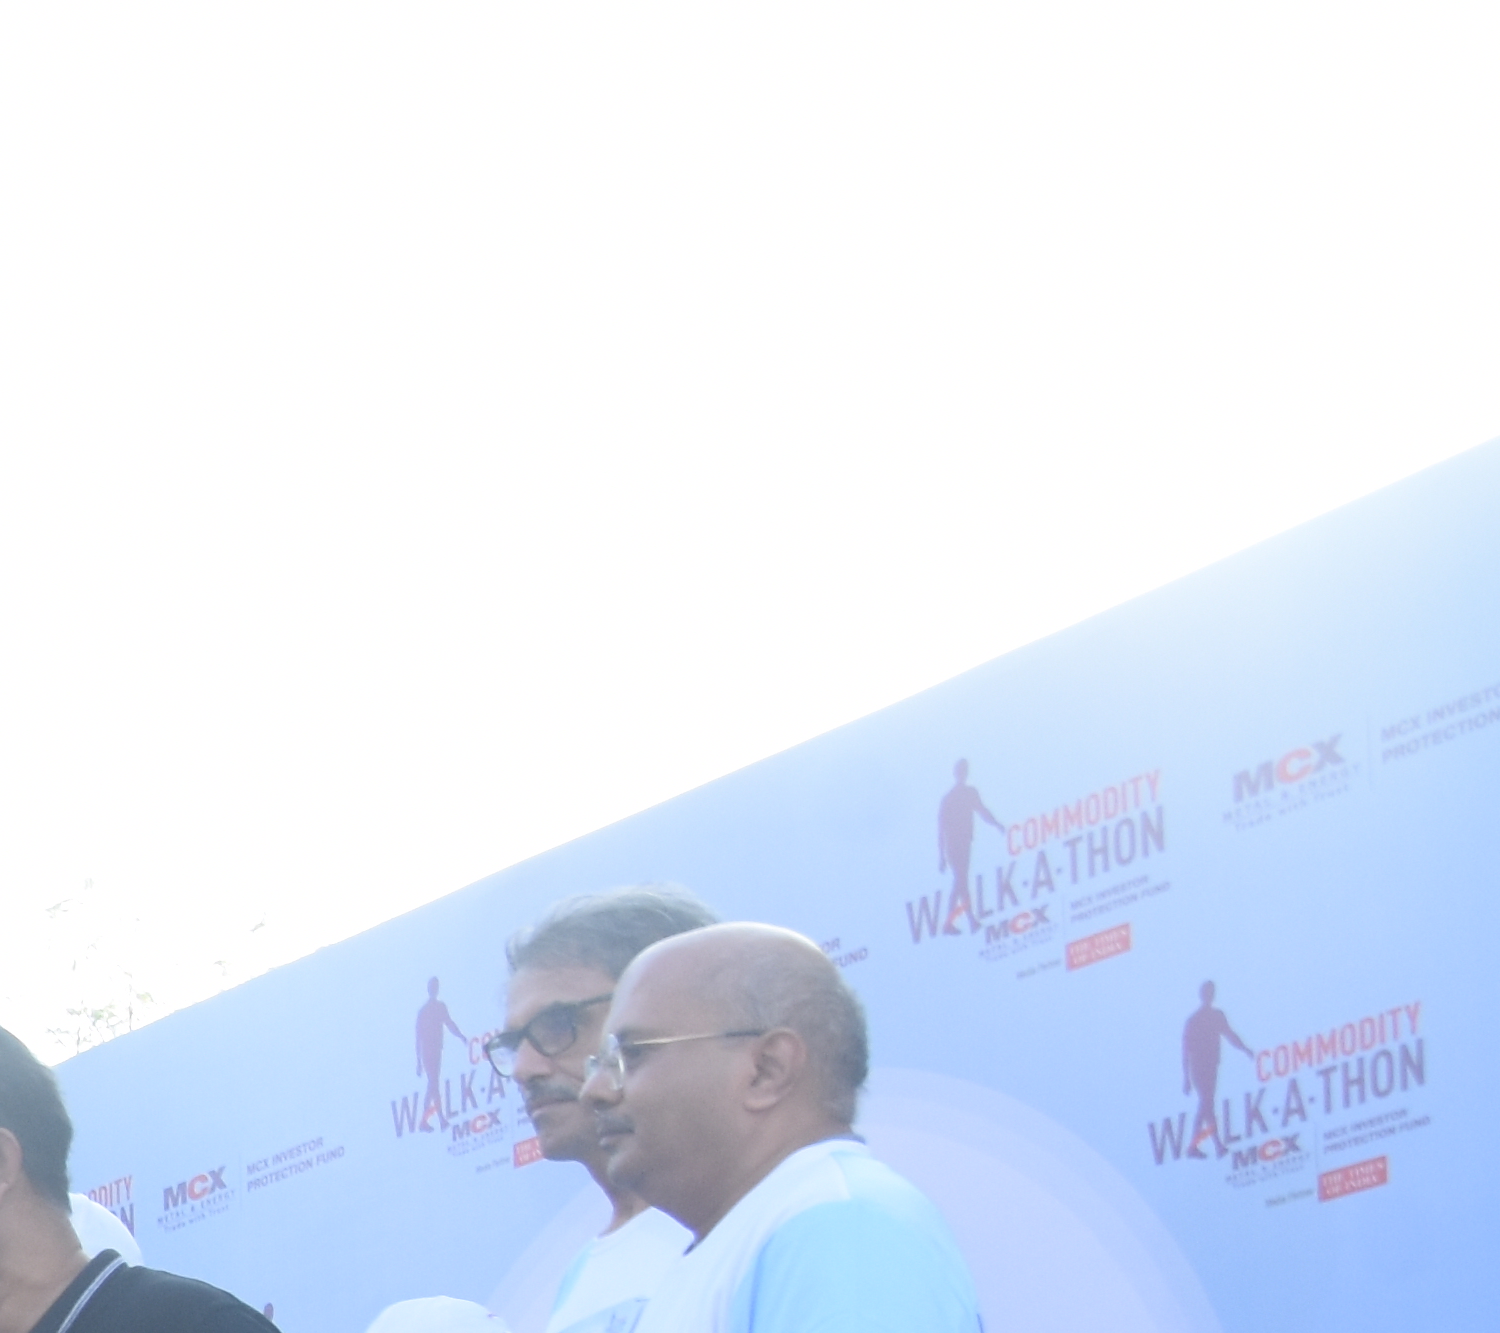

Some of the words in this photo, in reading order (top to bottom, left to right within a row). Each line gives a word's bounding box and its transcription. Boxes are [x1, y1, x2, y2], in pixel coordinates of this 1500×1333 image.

[1233, 733, 1345, 802] MCX
[1007, 769, 1164, 857] COMMODITY
[1256, 1001, 1421, 1082] COMMODITY
[162, 1166, 227, 1212] MCX
